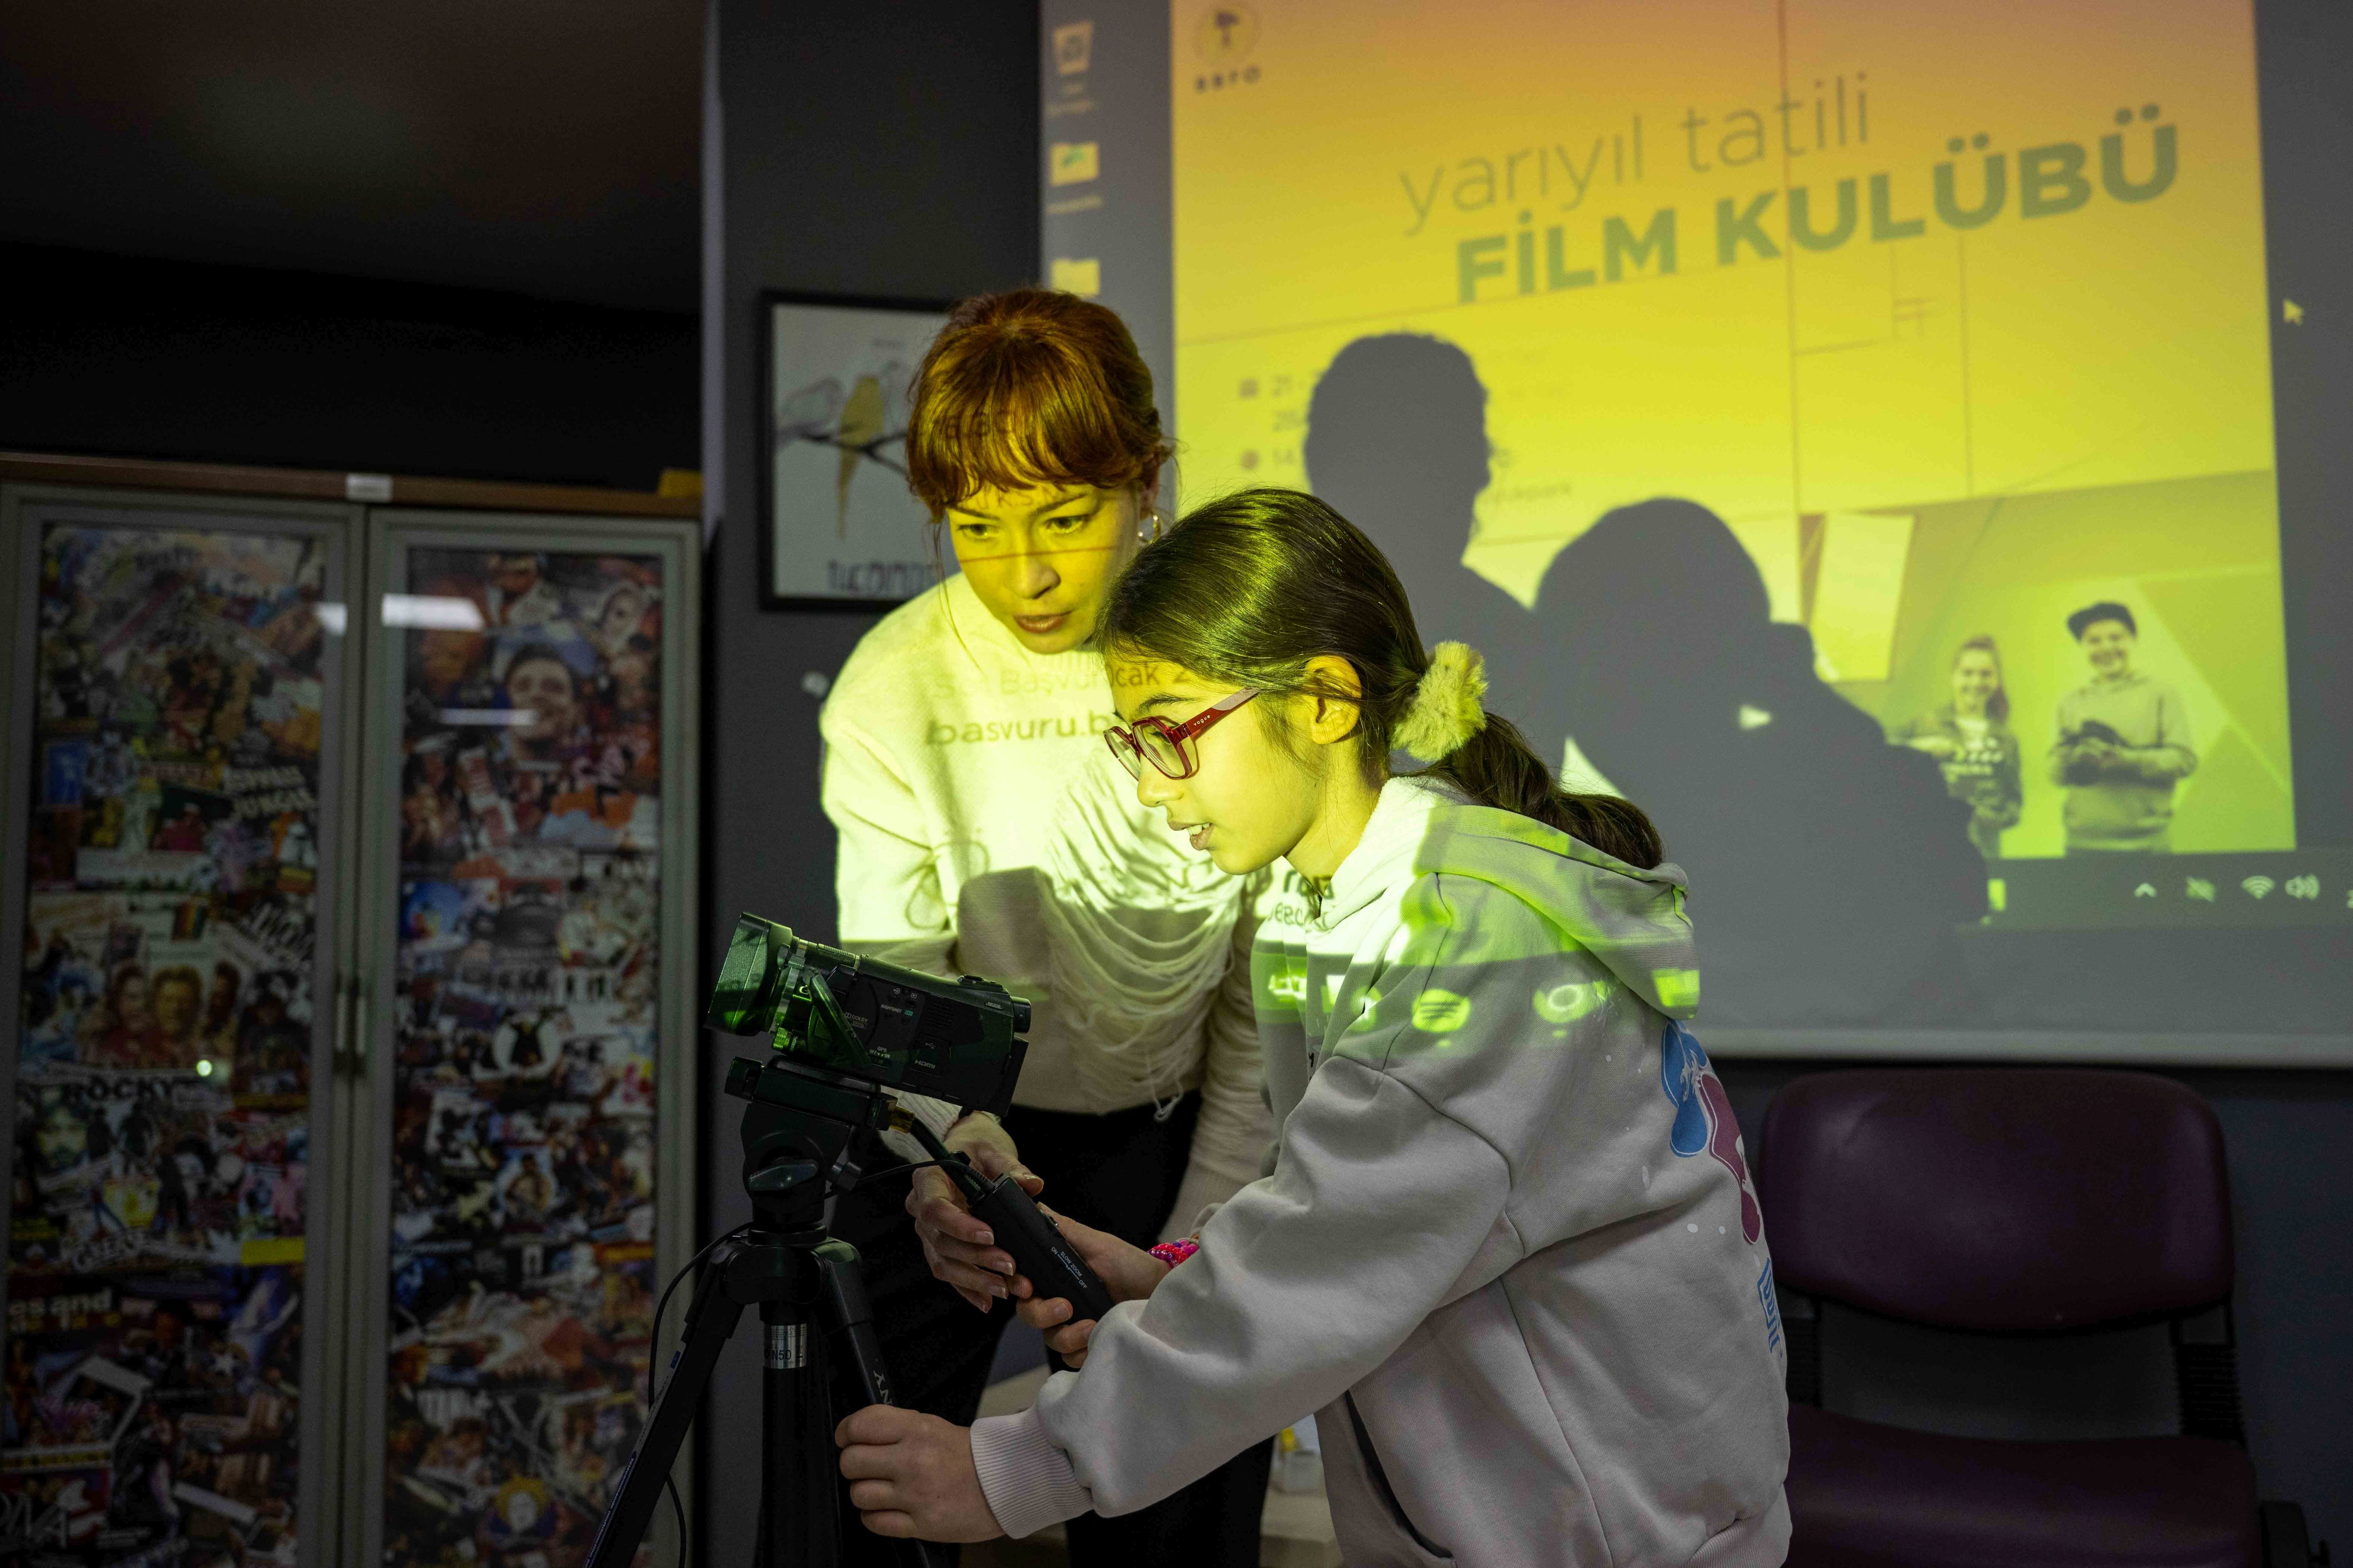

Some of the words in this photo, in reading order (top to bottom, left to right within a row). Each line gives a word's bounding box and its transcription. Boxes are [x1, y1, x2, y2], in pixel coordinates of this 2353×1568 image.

[1399, 113, 1643, 237] yarıyıl
[1681, 71, 1868, 173] tatili
[1456, 207, 1678, 304] FİLM
[1714, 103, 2178, 267] KULÜBÜ
[1193, 714, 1211, 726] vogue
[881, 1004, 902, 1014] NIGHTSHOT
[988, 1001, 1002, 1009] MODE
[851, 1014, 869, 1024] DOLBY
[915, 1059, 936, 1069] HDMI
[1051, 1247, 1059, 1255] ON
[1060, 1251, 1072, 1264] SLOW
[1070, 1263, 1083, 1277] ZOOM
[1079, 1280, 1088, 1288] OFF
